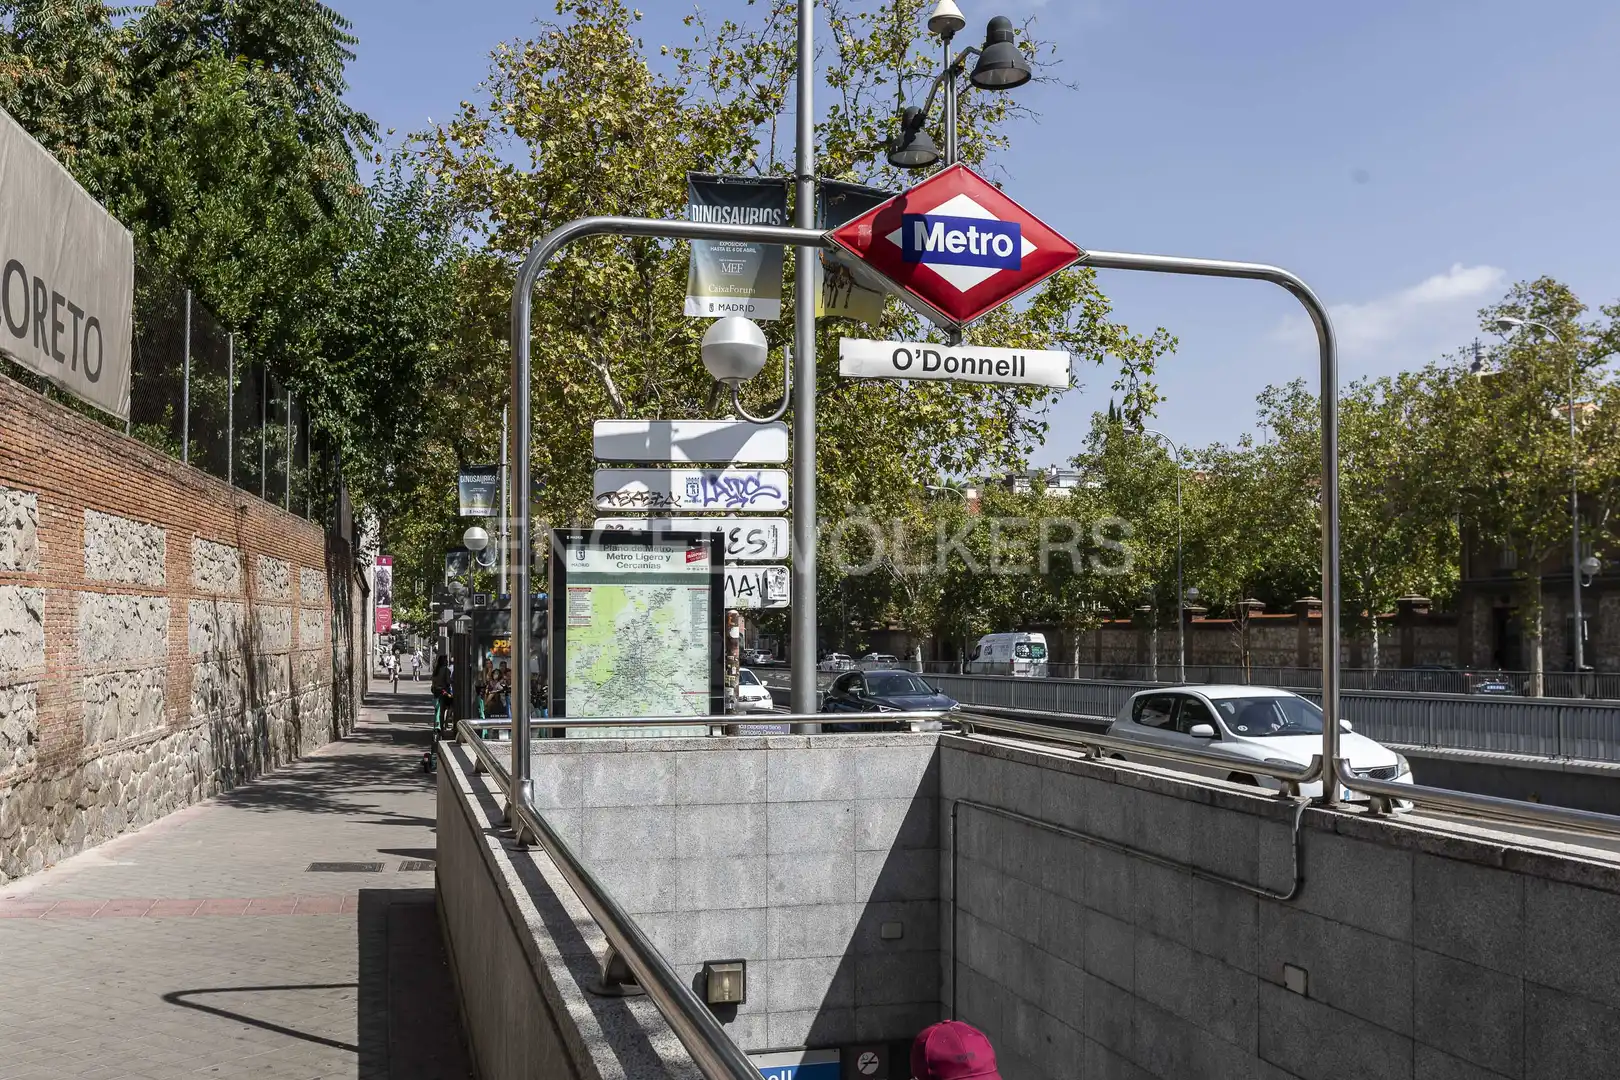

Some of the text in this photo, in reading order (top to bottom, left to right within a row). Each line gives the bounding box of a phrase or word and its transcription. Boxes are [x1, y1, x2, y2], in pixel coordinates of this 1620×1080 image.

[692, 204, 781, 226] DINOSAURIOS
[914, 221, 1014, 257] Metro
[708, 283, 756, 295] CaixaForum
[718, 303, 755, 313] MADRID
[0, 259, 103, 383] ORETO
[892, 347, 1026, 378] O'Donnell
[603, 544, 629, 552] Plano
[606, 553, 672, 562] Metro Ligero y
[616, 561, 662, 570] Cercanías
